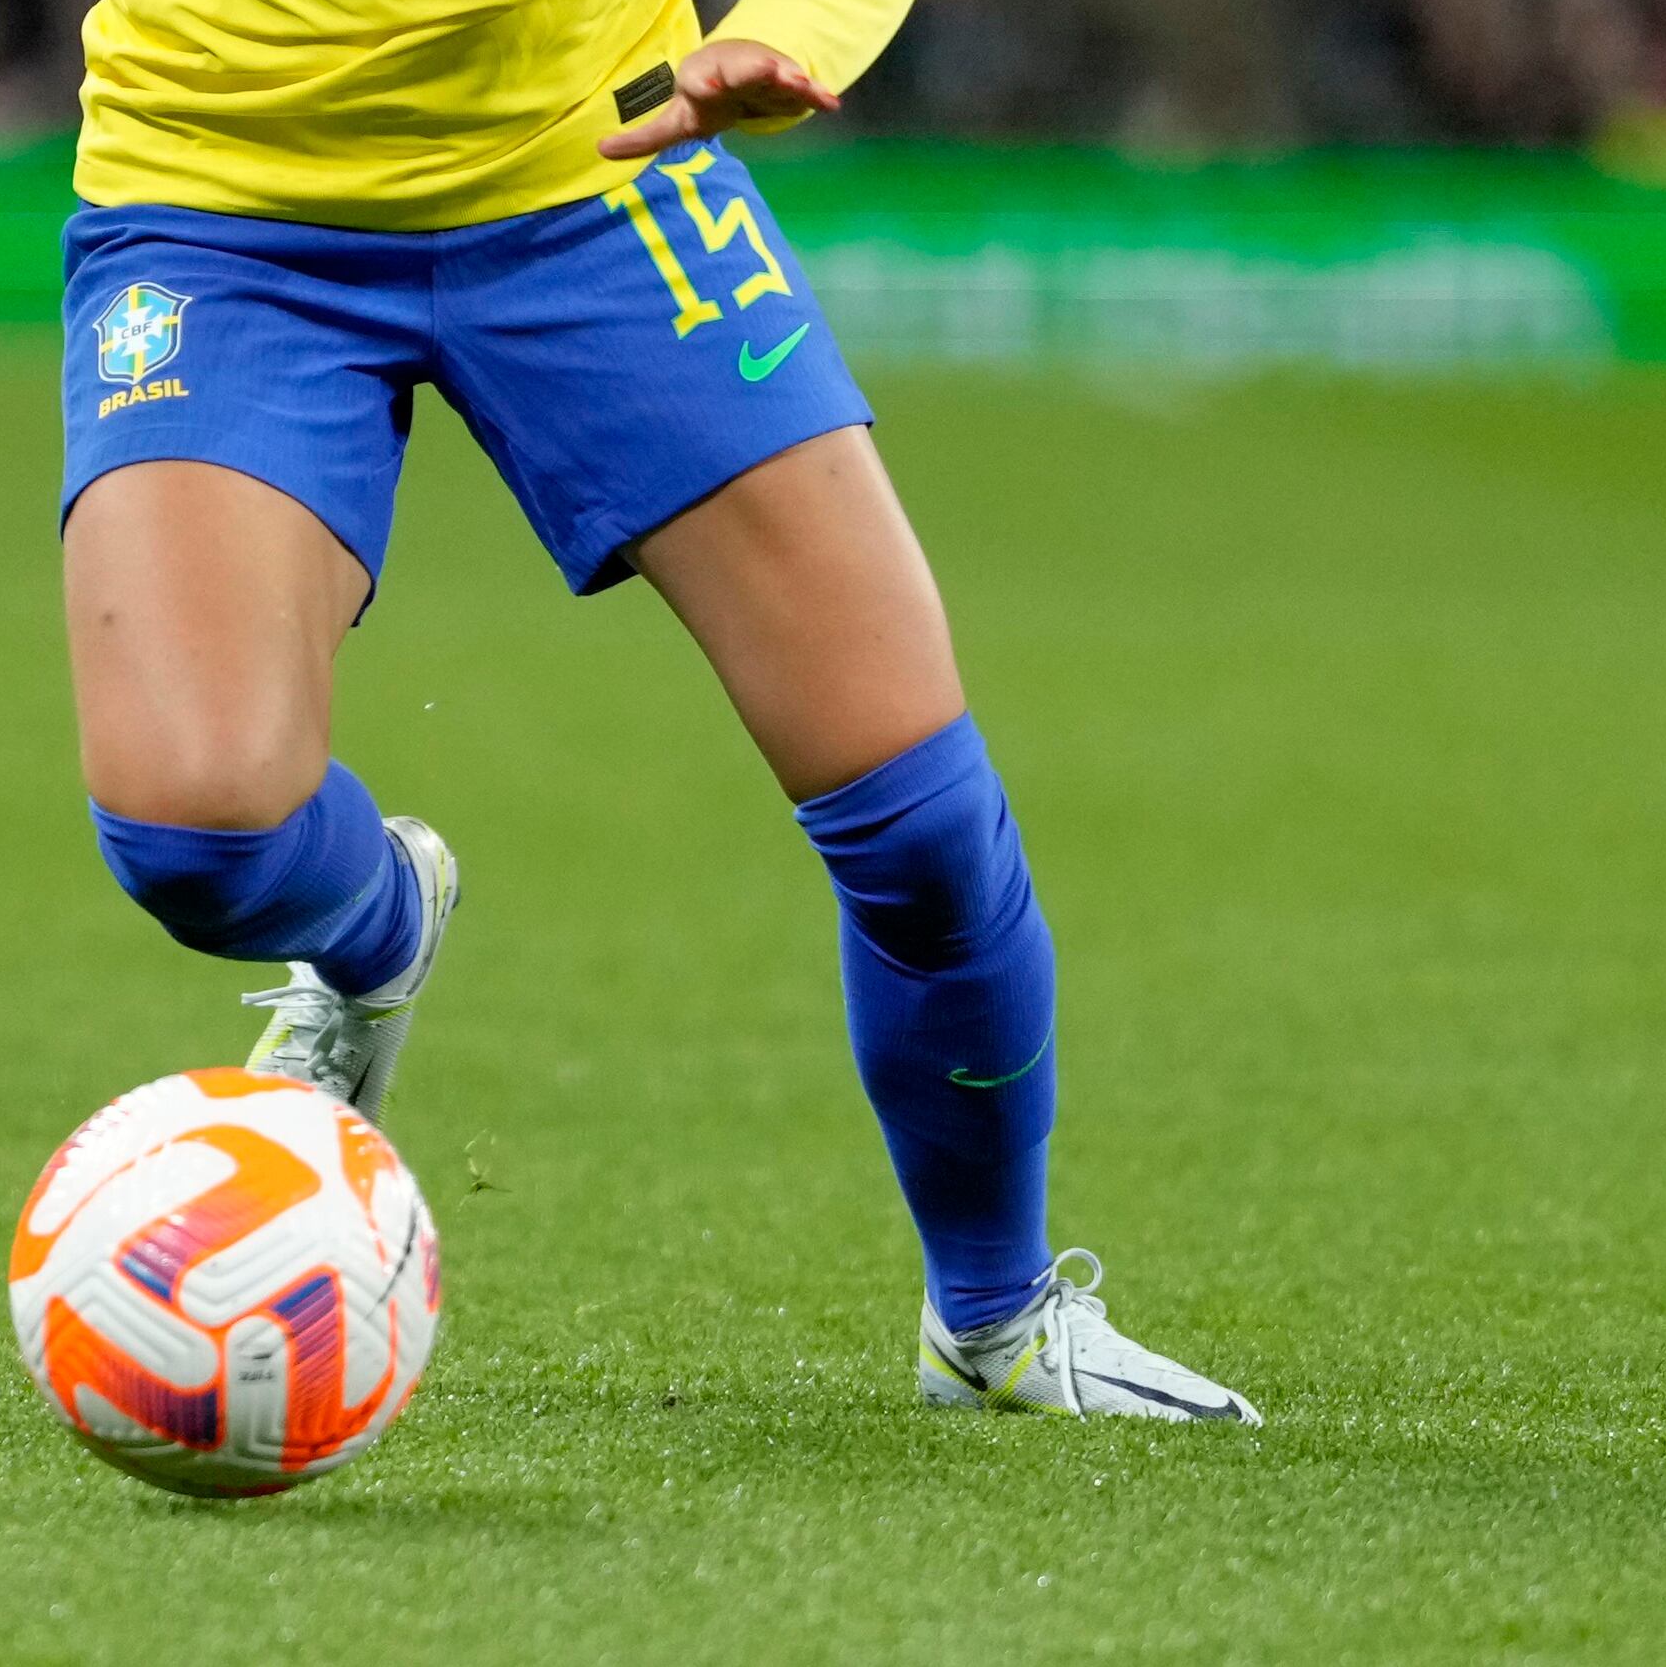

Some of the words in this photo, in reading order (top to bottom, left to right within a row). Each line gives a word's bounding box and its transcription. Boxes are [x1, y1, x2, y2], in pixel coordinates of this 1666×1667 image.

[601, 146, 793, 339] 15
[121, 321, 153, 340] CBF
[98, 378, 190, 419] BRASIL
